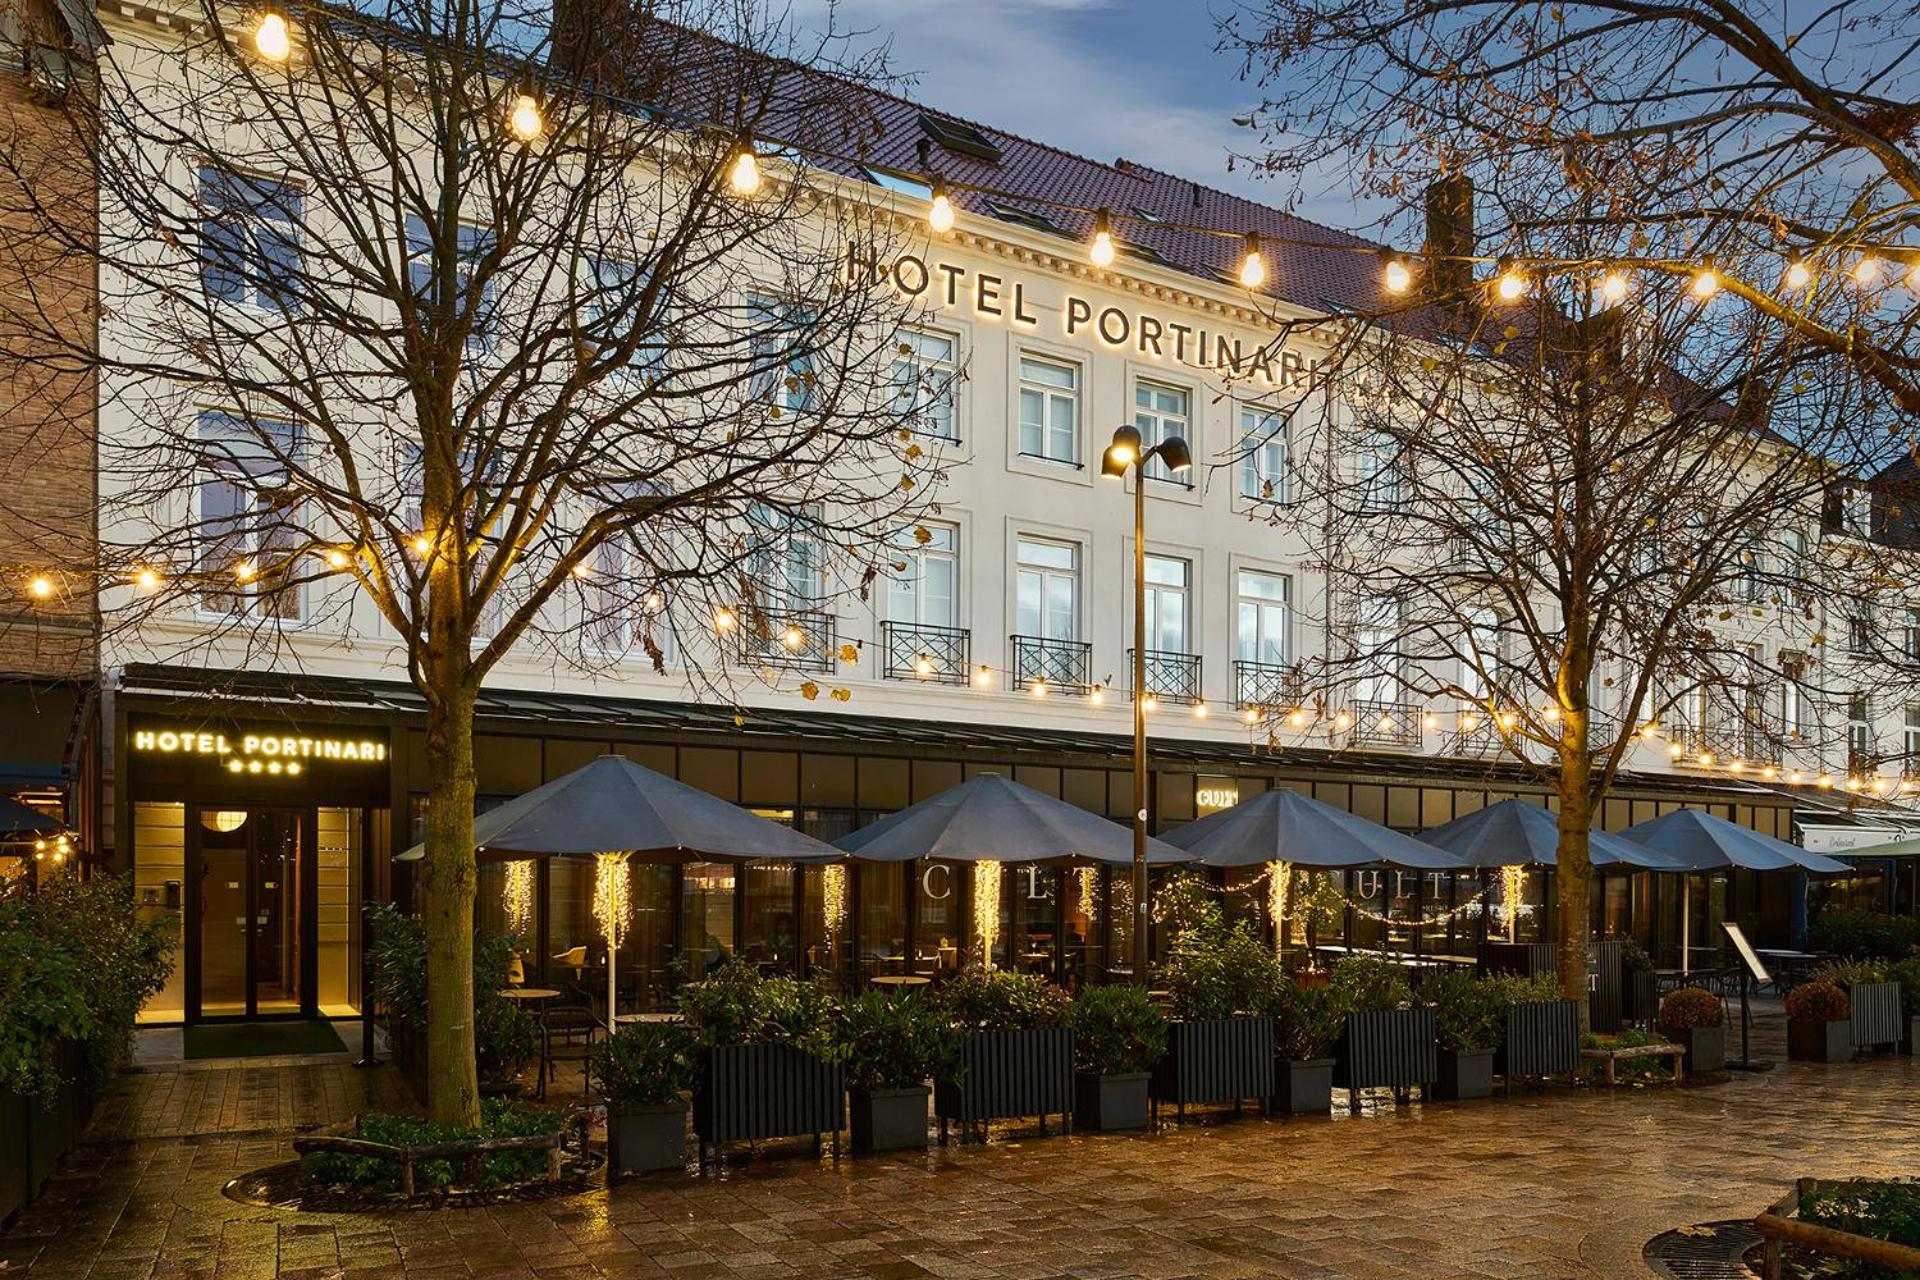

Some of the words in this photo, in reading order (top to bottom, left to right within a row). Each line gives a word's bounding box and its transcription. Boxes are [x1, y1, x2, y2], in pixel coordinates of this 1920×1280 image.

[848, 241, 1037, 325] HOTEL
[1067, 296, 1317, 390] PORTINARI
[136, 731, 231, 754] HOTEL
[244, 736, 385, 761] PORTINARI
[922, 864, 1096, 900] CLT
